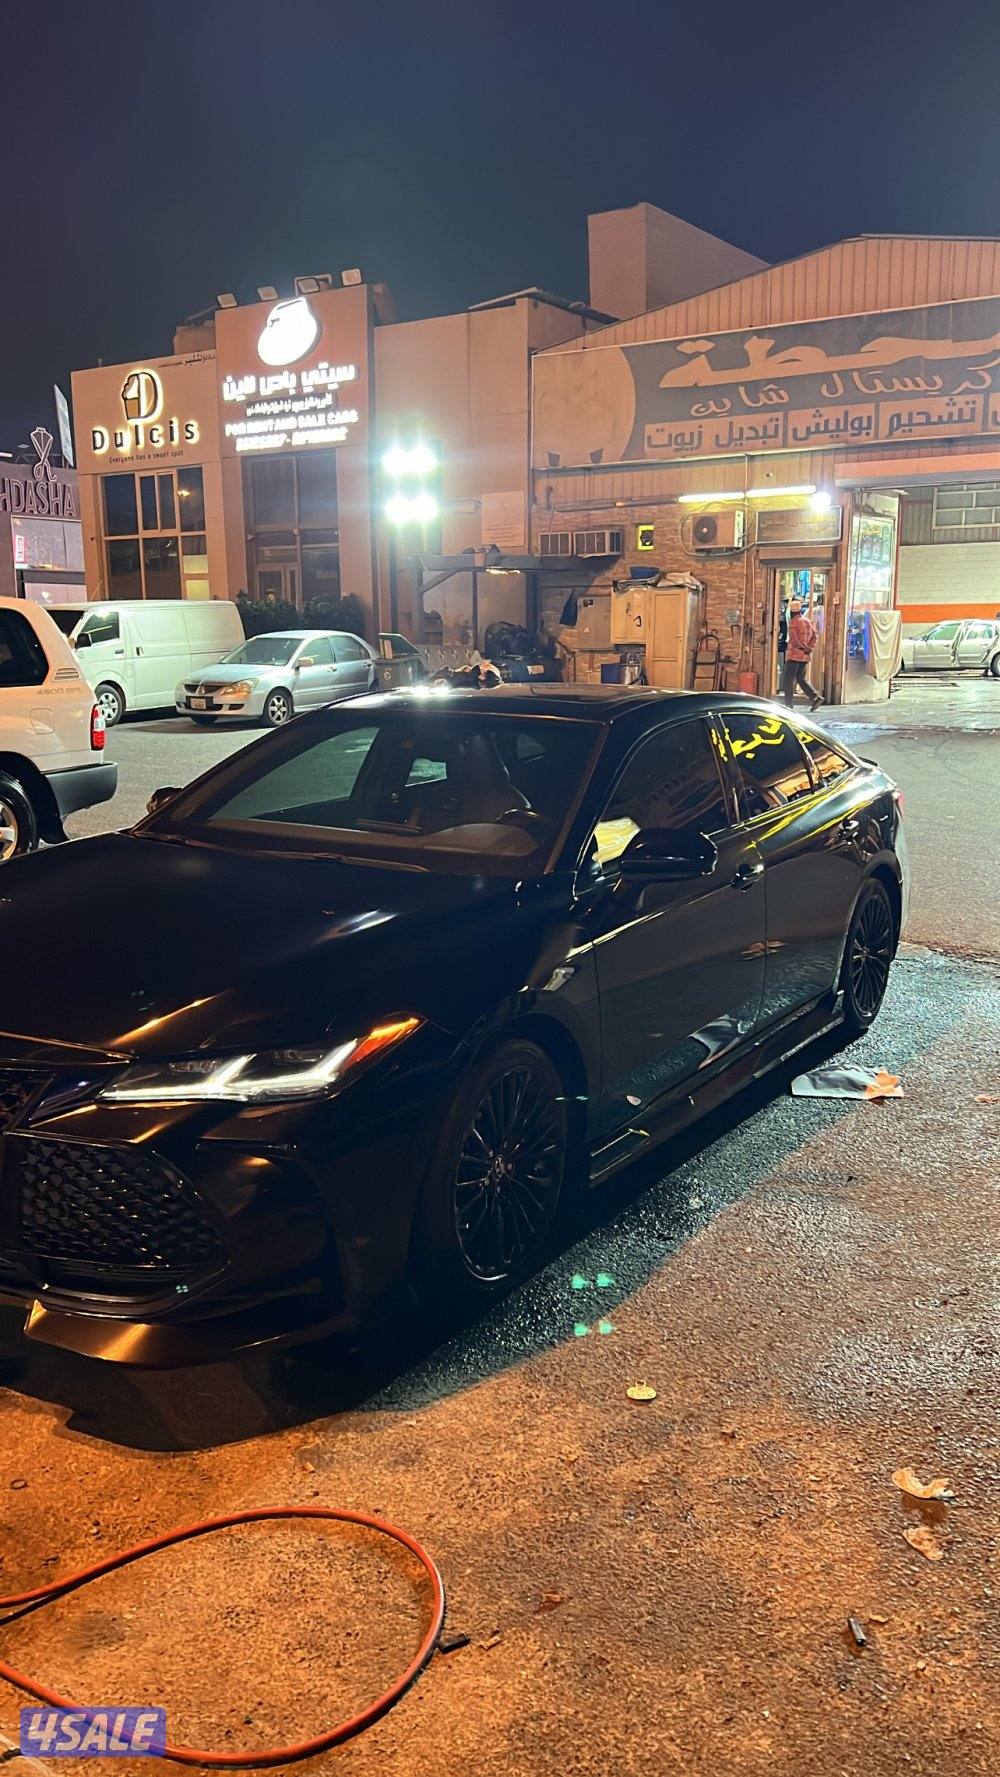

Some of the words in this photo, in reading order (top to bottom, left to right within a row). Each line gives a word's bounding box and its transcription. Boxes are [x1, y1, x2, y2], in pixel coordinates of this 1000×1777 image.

[714, 416, 780, 448] تبديل
[792, 409, 873, 441] بوليش
[885, 398, 977, 439] تشحيم
[92, 419, 197, 452] Dulcis
[646, 424, 703, 451] زيوت
